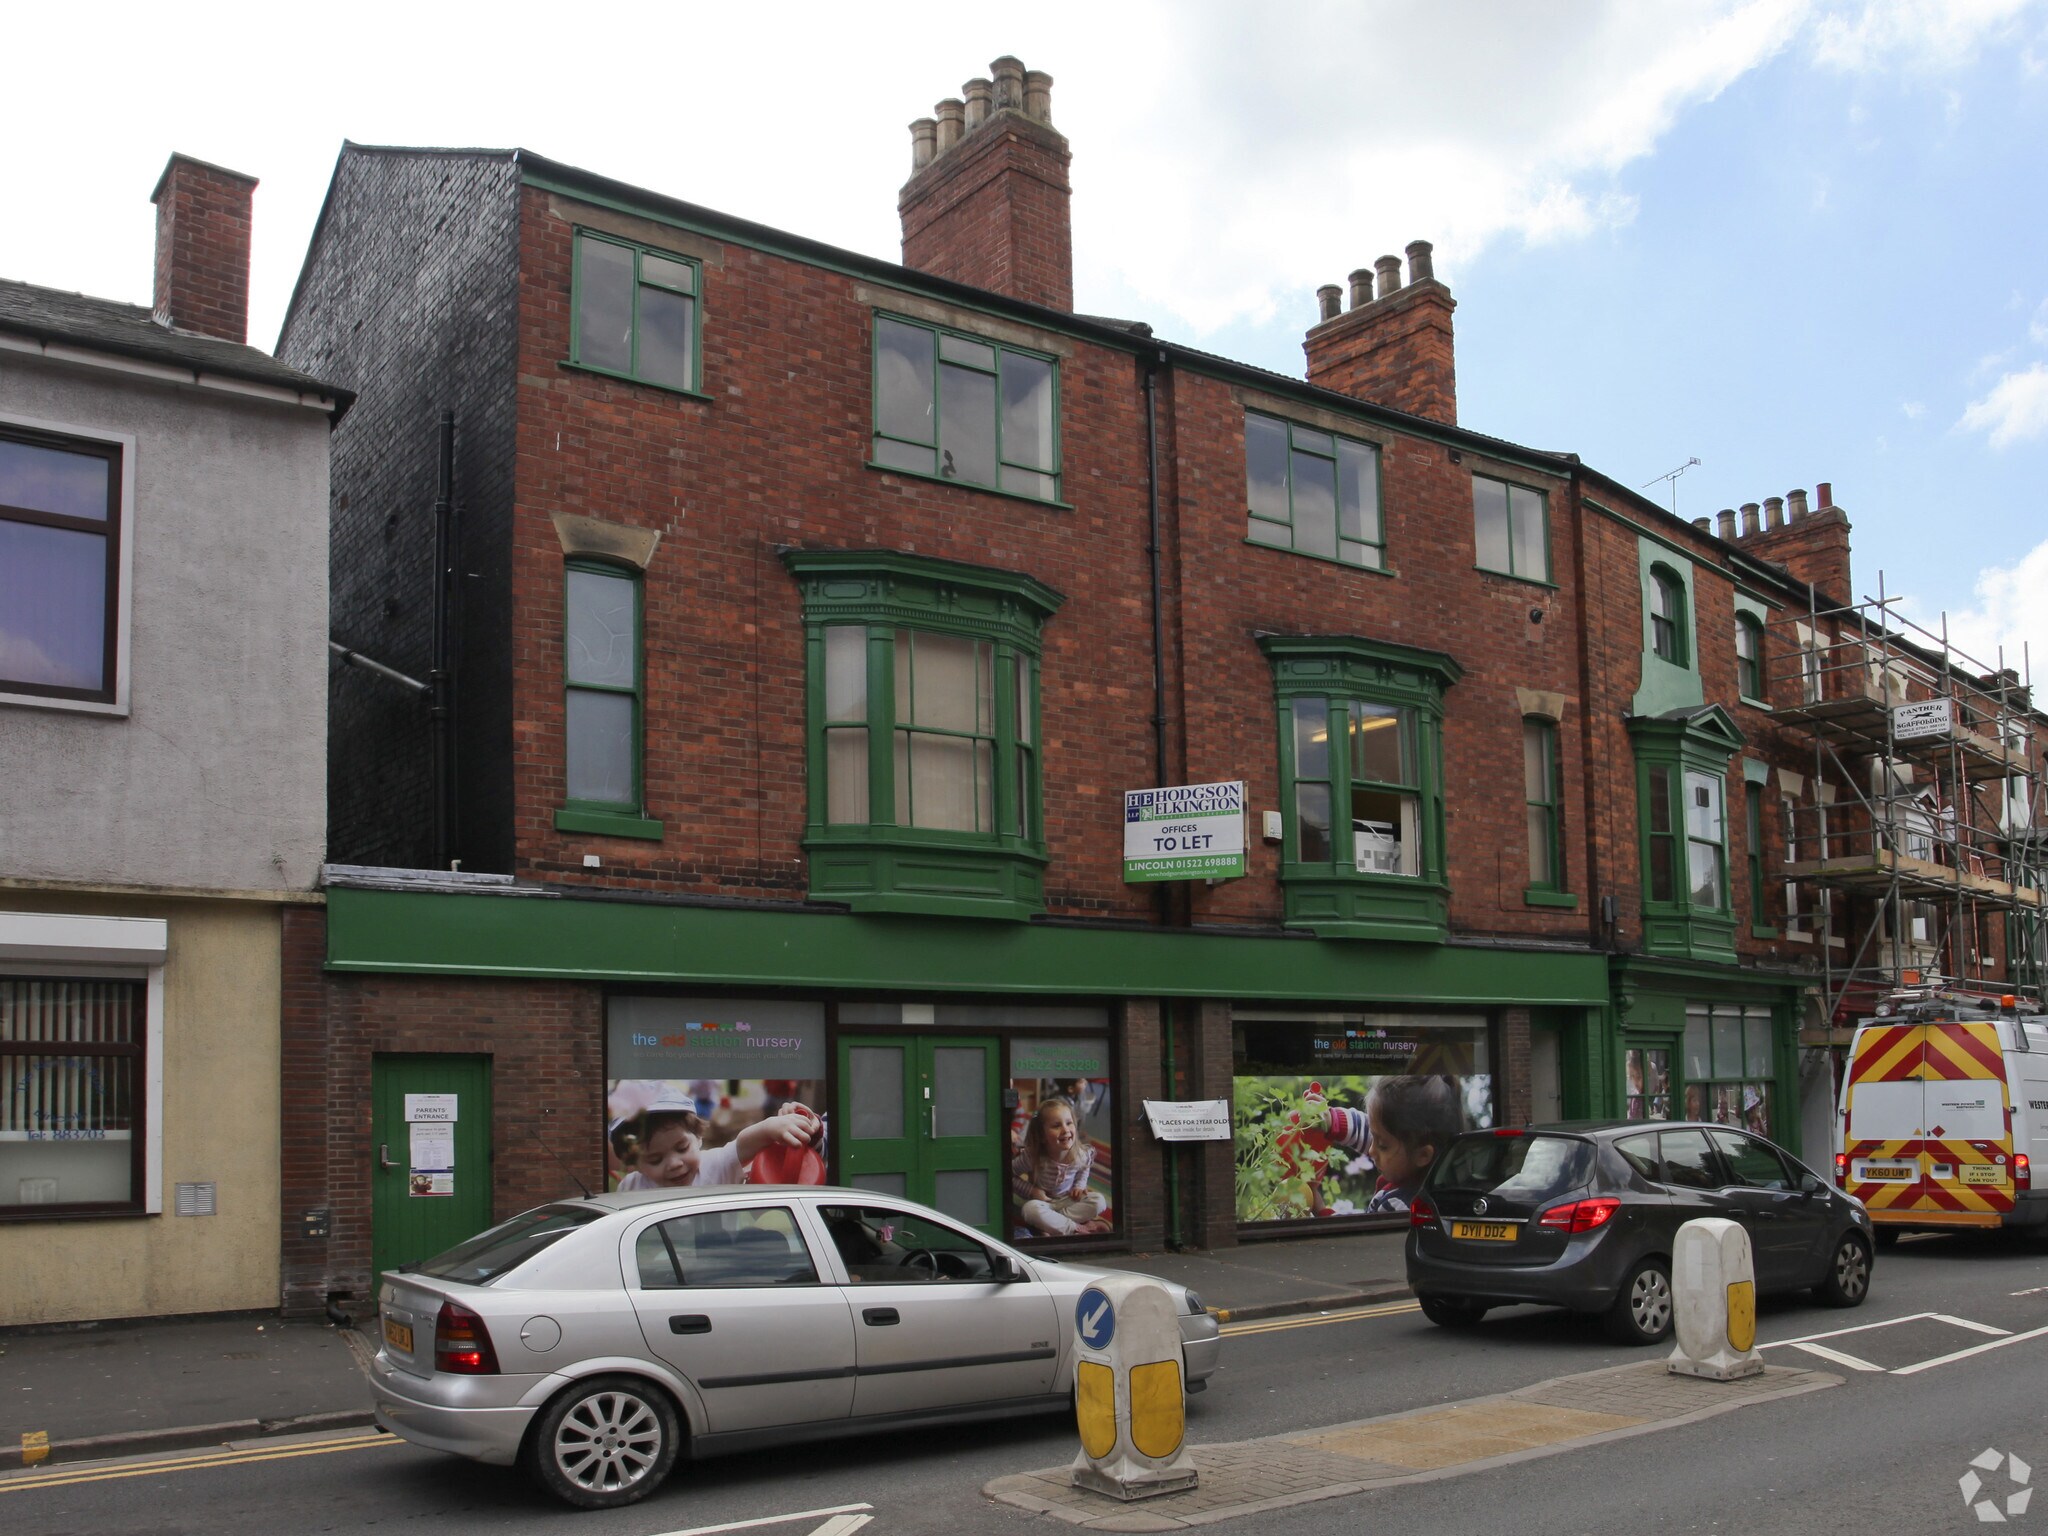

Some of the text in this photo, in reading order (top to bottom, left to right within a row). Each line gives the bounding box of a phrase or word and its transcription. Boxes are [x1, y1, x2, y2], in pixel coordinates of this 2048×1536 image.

[1900, 704, 1942, 716] PANTHER
[1155, 784, 1239, 802] HODGSON
[1155, 797, 1239, 815] ELKINGTON
[1162, 824, 1197, 834] OFFICES
[1153, 834, 1213, 852] TO LET
[1129, 857, 1237, 871] LINCOLN 01522 698888
[632, 1033, 802, 1051] the old station nursery
[1314, 1039, 1417, 1052] the old station nursery
[1016, 1059, 1052, 1070] 01522
[27, 1129, 105, 1141] Tel: 883703
[1865, 1168, 1891, 1178] YK60
[1461, 1224, 1506, 1238] DY11 DDZ
